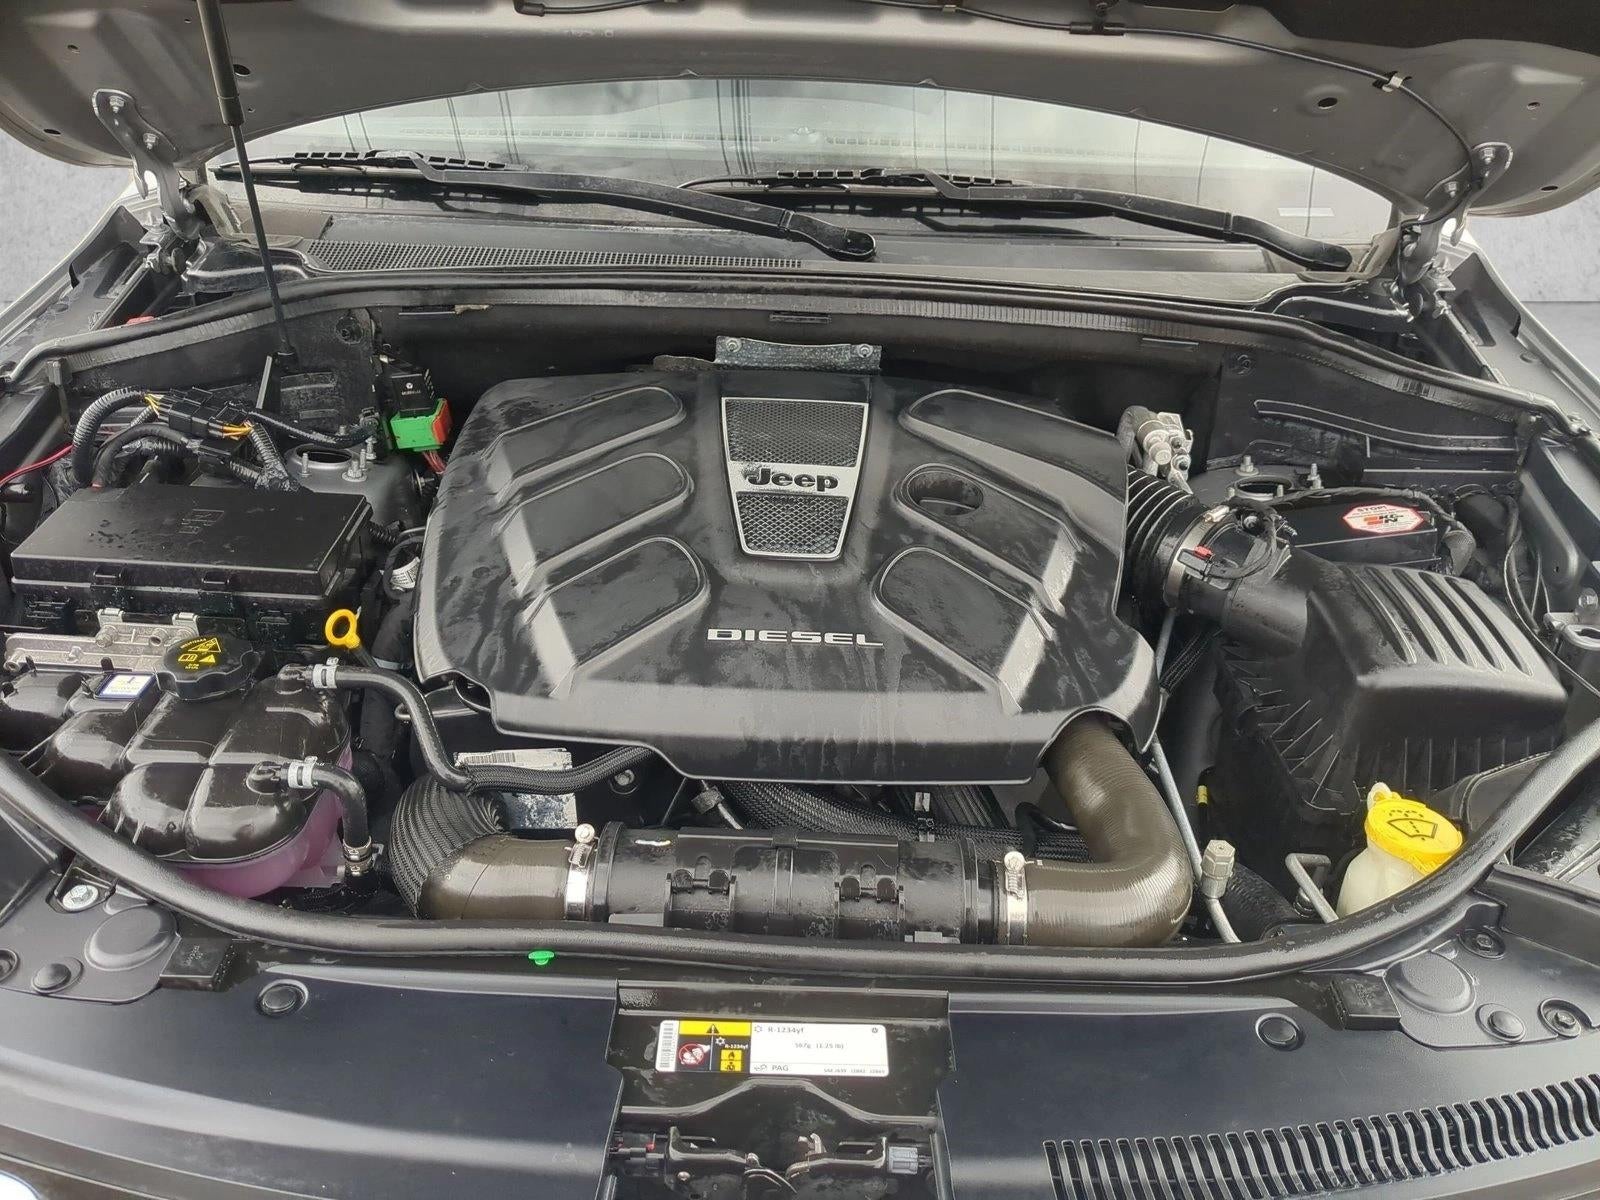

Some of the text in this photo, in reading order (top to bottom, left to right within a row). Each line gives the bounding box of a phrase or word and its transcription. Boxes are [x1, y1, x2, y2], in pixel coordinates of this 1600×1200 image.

[747, 468, 839, 492] Jeep
[707, 628, 884, 647] DIESEL
[767, 1026, 804, 1035] R-1234yf
